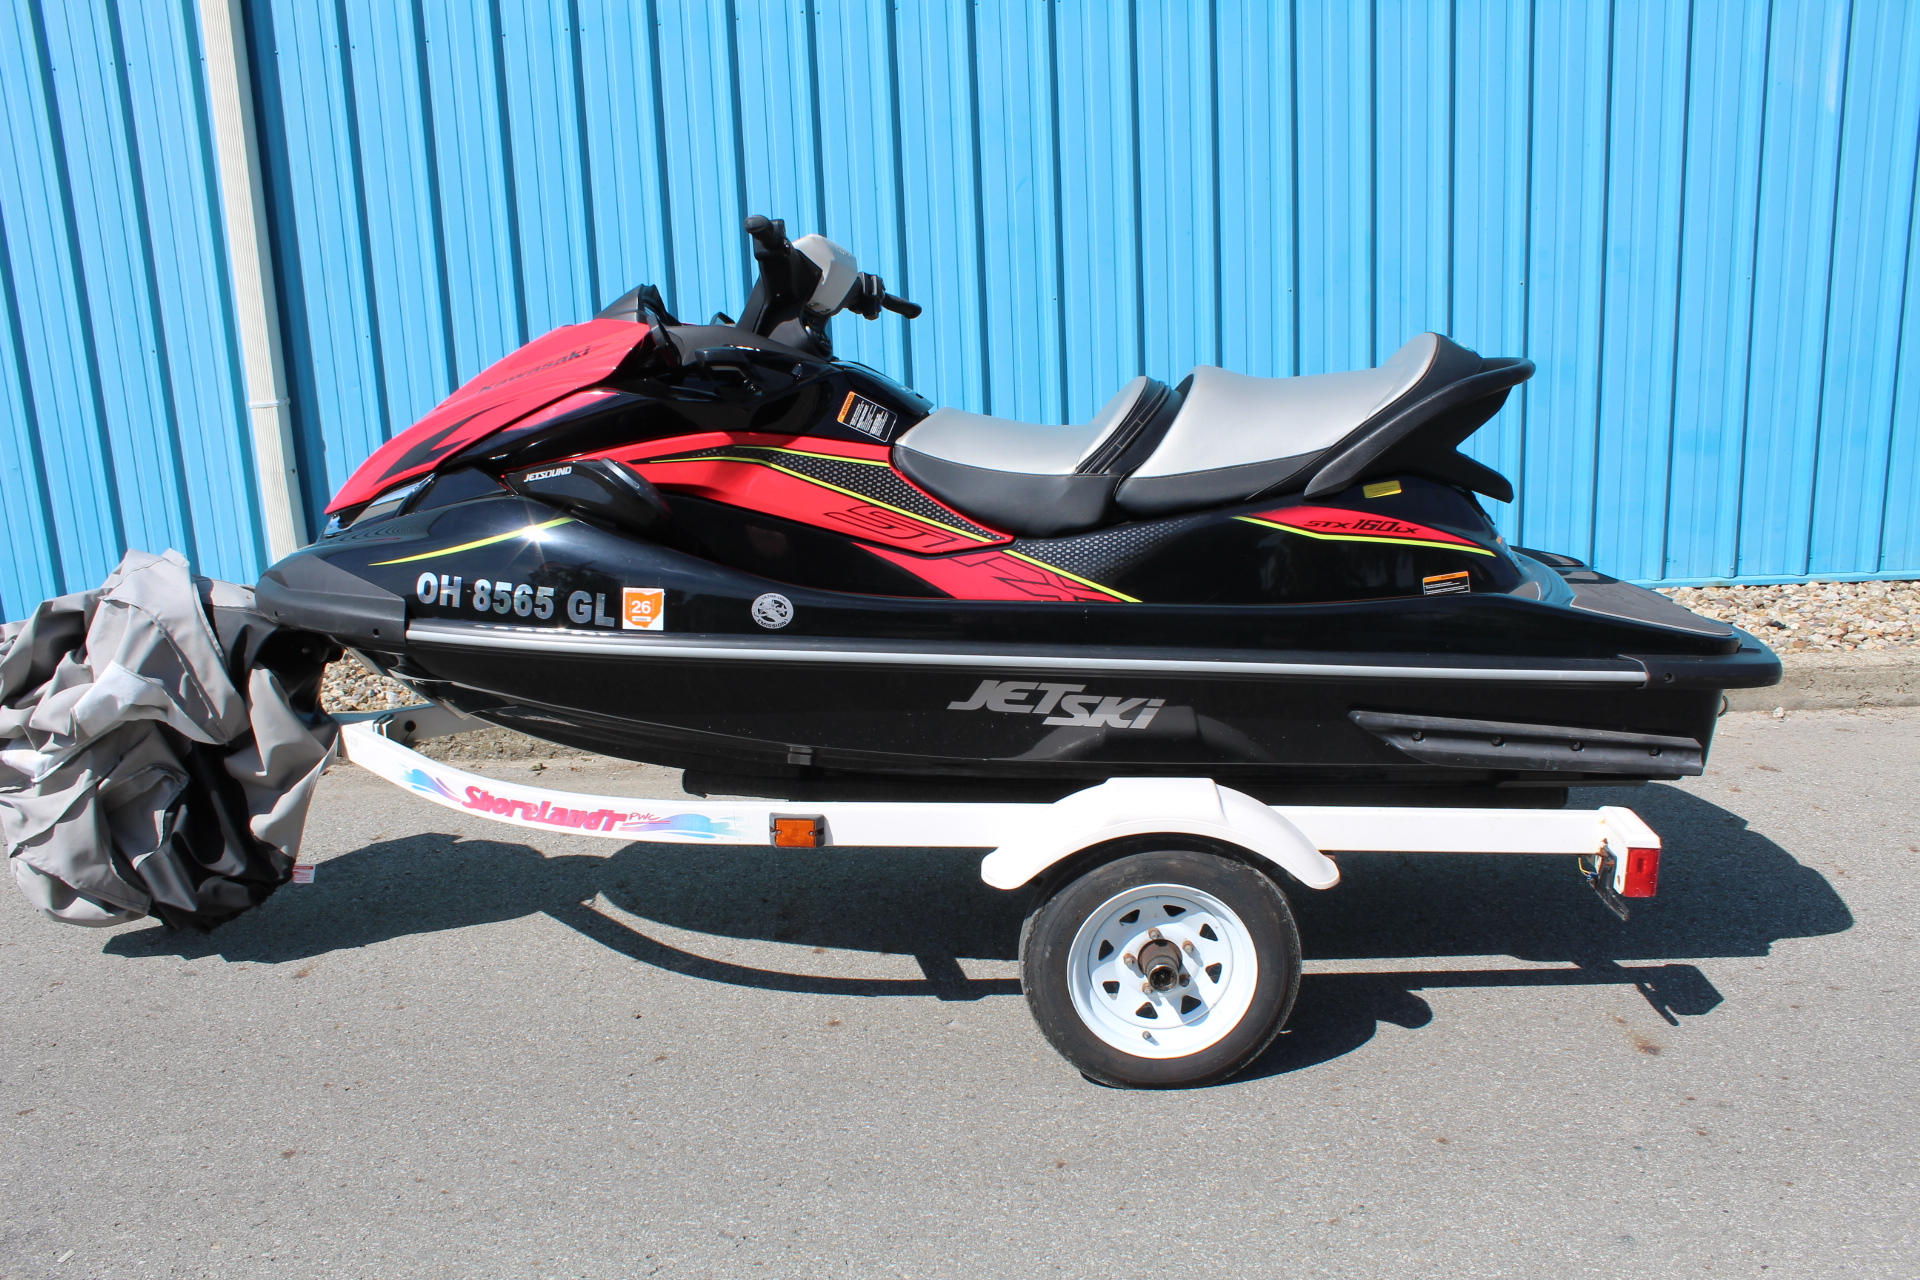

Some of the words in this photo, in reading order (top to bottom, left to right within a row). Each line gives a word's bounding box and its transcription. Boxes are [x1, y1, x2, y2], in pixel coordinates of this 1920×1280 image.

[523, 465, 573, 483] JETSOUND
[416, 571, 463, 608] OH
[472, 578, 555, 620] 8565
[567, 590, 615, 627] GL
[631, 600, 652, 614] 26
[629, 812, 661, 821] PWC
